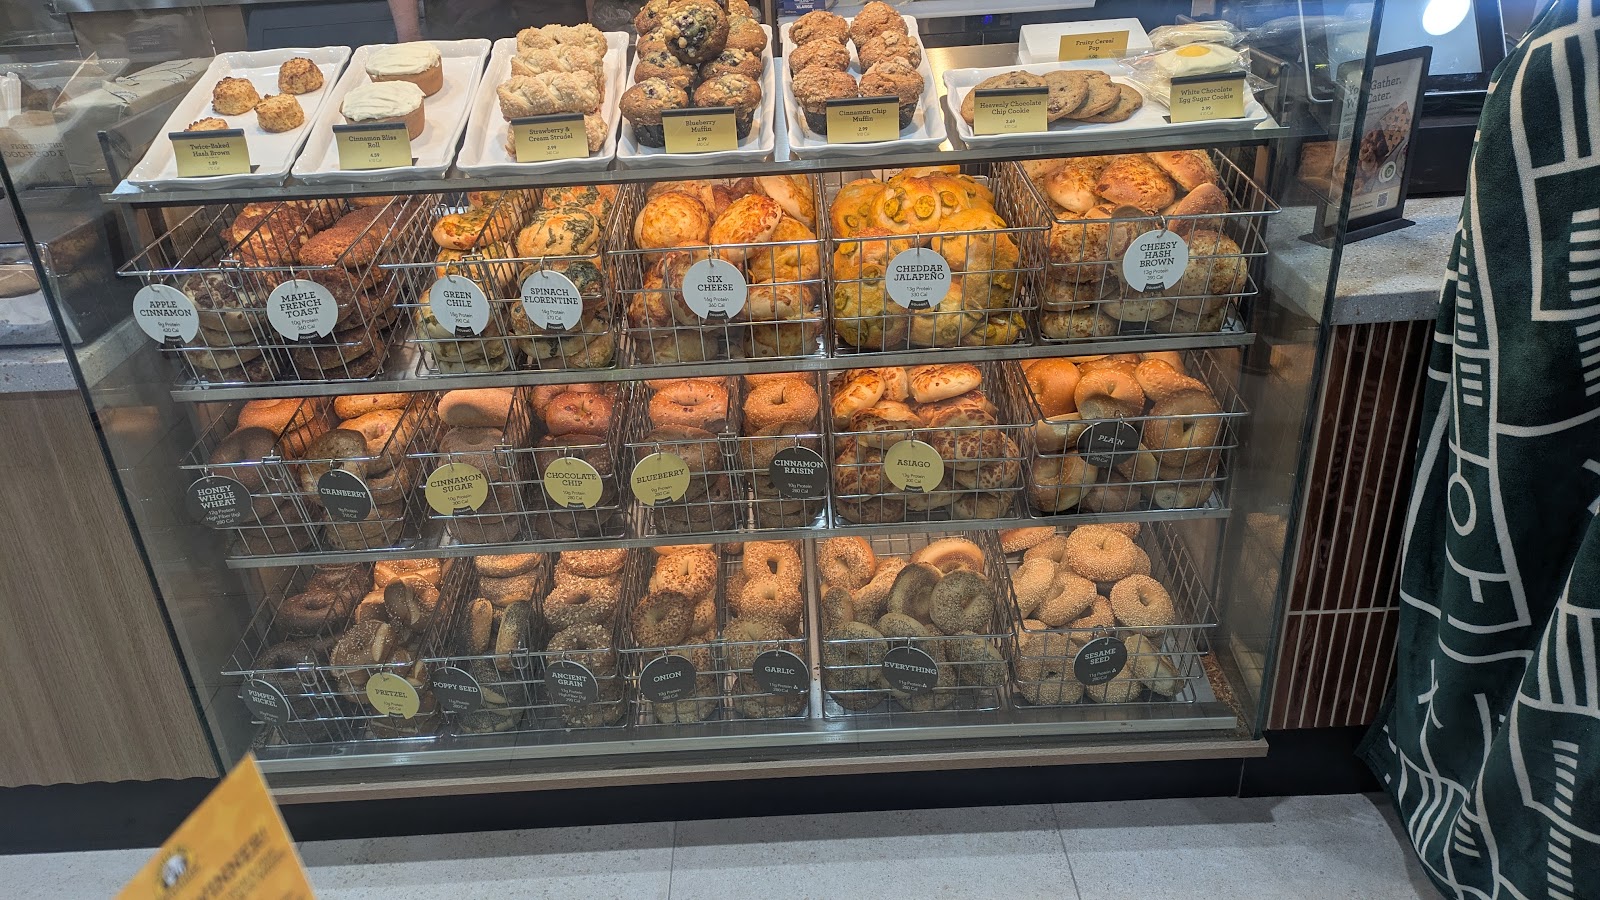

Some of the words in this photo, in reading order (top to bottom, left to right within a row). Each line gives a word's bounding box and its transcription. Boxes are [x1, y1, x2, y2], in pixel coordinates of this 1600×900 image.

[1370, 76, 1402, 90] Gather.
[1201, 86, 1232, 94] Chocolate
[529, 127, 563, 135] Strawberry
[190, 142, 230, 150] Twice-Baked
[1140, 241, 1178, 251] CHEESY
[1144, 250, 1172, 259] HASH
[1140, 258, 1175, 268] BROWN
[894, 272, 944, 281] JALAPEÑO
[281, 292, 316, 302] MAPLE
[443, 291, 472, 299] GREEN
[530, 288, 569, 296] SPINACH
[280, 299, 322, 311] FRENCH
[446, 299, 472, 307] CHILE
[524, 296, 578, 305] FLORENTINE
[285, 307, 320, 318] TOAST
[1098, 434, 1125, 446] PLAN
[774, 460, 824, 468] CINNAMON
[897, 459, 930, 468] ASIAGO
[431, 474, 482, 488] CINNAMON
[546, 472, 597, 480] CHOCOLATE
[636, 469, 684, 484] BLUEBERRY
[197, 485, 231, 496] HONEY
[321, 488, 366, 498] CRANBERRY
[442, 483, 473, 493] SUGAR
[198, 492, 235, 502] WHOLE
[200, 498, 236, 509] WHEAT
[1084, 648, 1116, 660] SESAME
[1090, 656, 1110, 665] SEED
[764, 666, 795, 675] GARLIC
[884, 661, 937, 675] EVERYTHING
[552, 672, 587, 682] ANCIENT
[653, 671, 682, 682] ONION
[433, 681, 457, 690] POPPY
[459, 685, 478, 693] SEED
[558, 679, 583, 687] GRAIN
[248, 689, 277, 701] PUMPER-
[375, 688, 408, 698] PRETZEL
[252, 696, 278, 707] NICKEL
